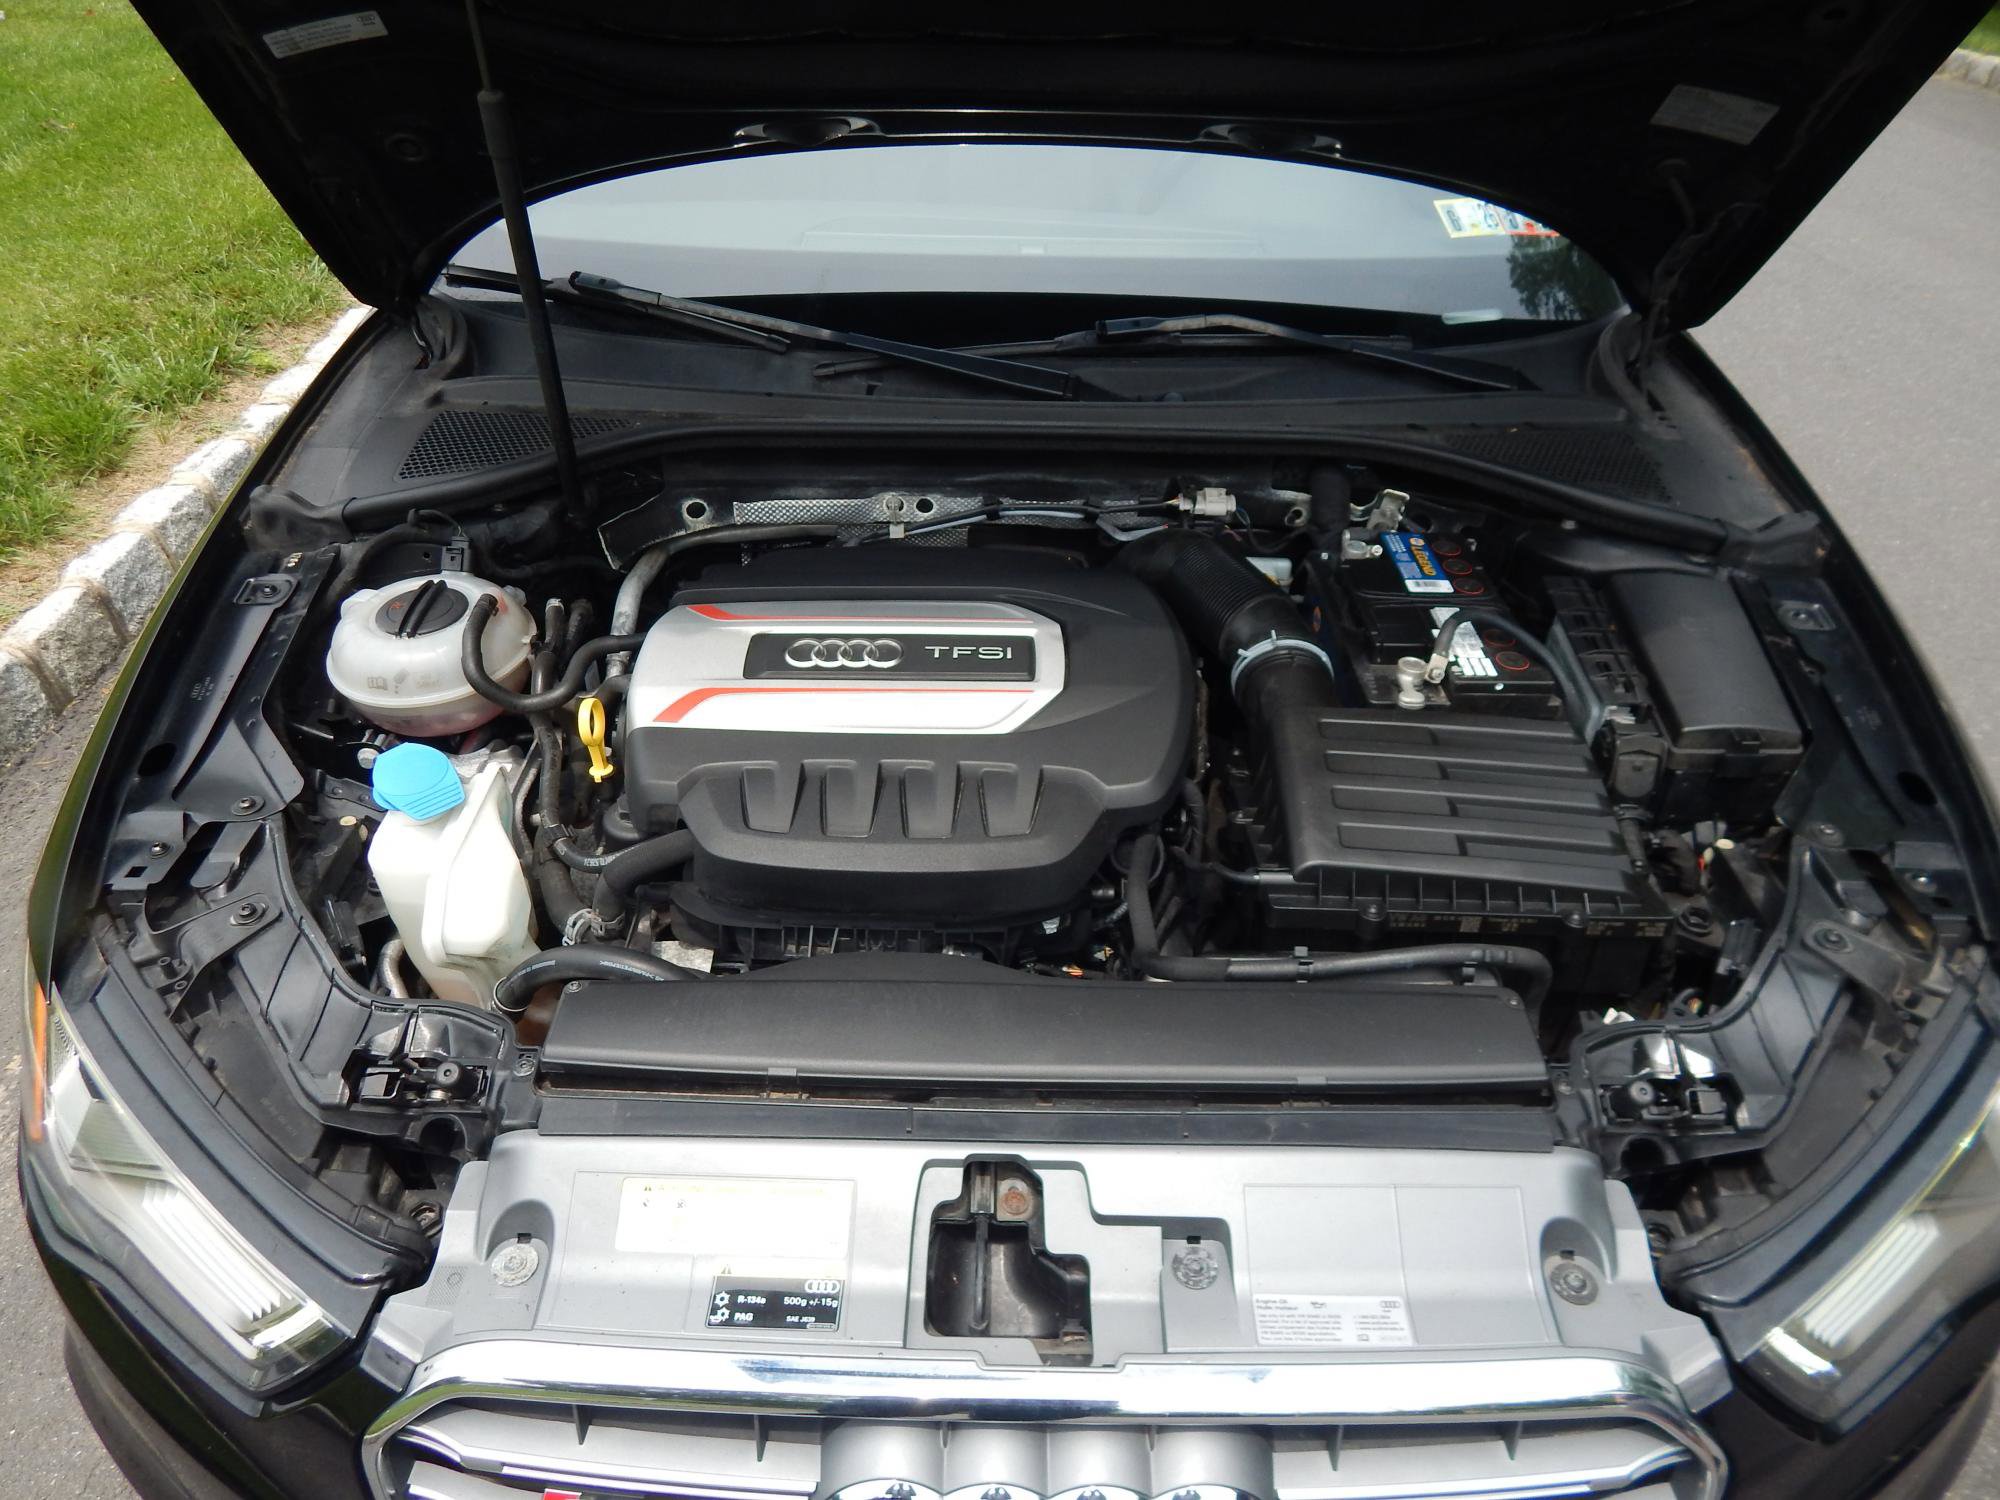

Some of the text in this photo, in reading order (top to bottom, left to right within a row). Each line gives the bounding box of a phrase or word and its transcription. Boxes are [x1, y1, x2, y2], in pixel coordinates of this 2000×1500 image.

[1411, 545, 1437, 576] LEGEND
[924, 646, 1013, 660] TFSI
[783, 1296, 807, 1307] 500g
[821, 1297, 838, 1308] 15g
[733, 1312, 754, 1322] PAG
